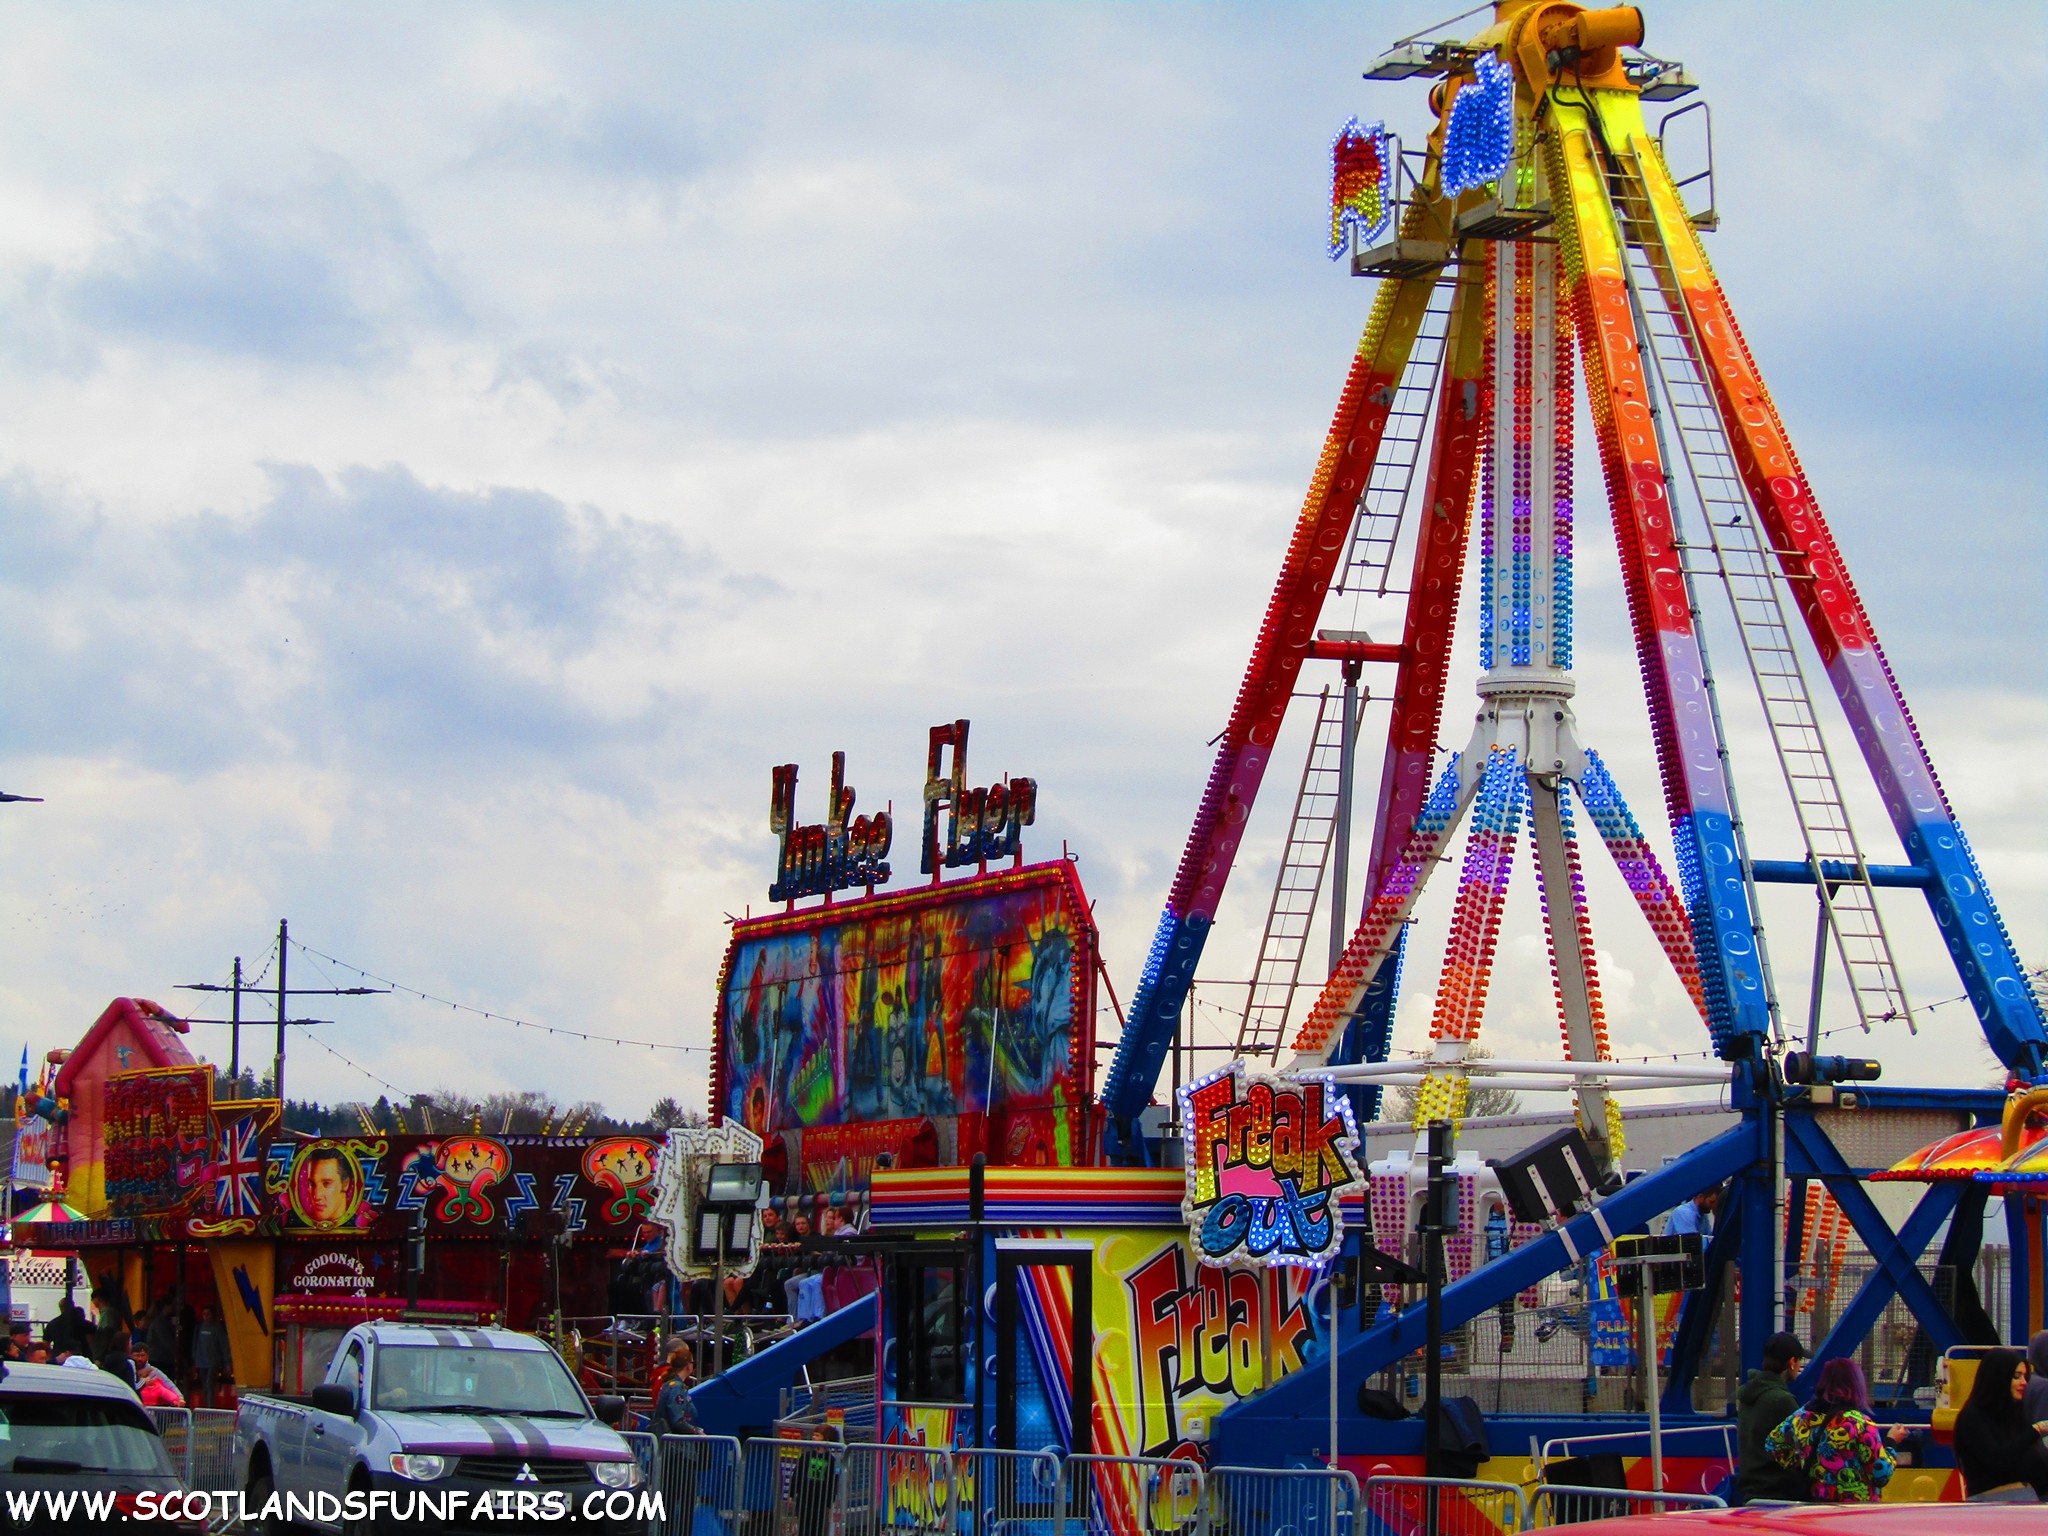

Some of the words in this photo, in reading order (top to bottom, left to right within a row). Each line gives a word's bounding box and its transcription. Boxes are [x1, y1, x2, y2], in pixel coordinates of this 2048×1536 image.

[1188, 1073, 1355, 1211] Freak
[1125, 1242, 1318, 1458] Freak
[1594, 1337, 1621, 1350] ALL
